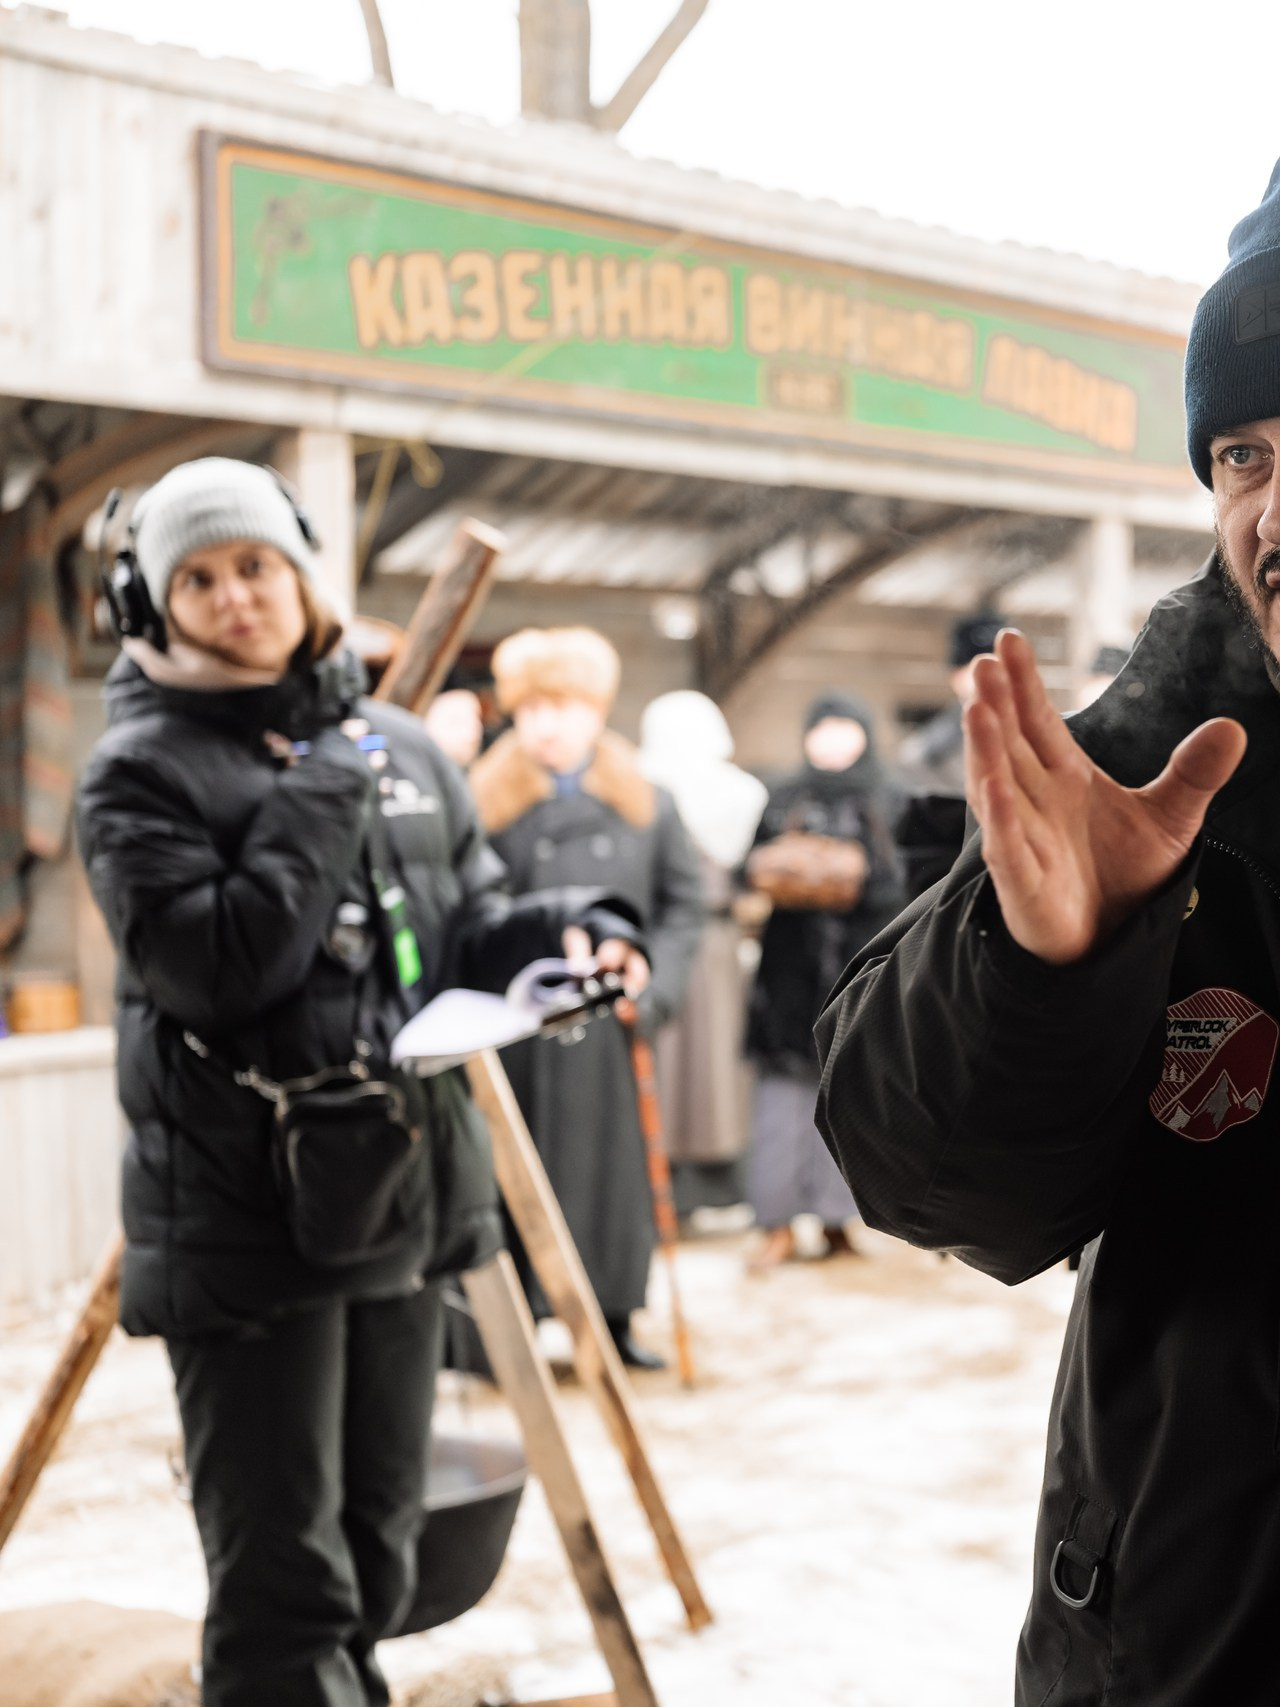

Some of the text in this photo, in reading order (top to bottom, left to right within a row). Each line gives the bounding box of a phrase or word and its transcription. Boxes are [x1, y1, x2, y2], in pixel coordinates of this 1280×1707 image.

[348, 248, 731, 350] КАЗЕННАЯ
[1166, 1020, 1229, 1034] YPERLOOK
[1165, 1035, 1212, 1050] ATROL
